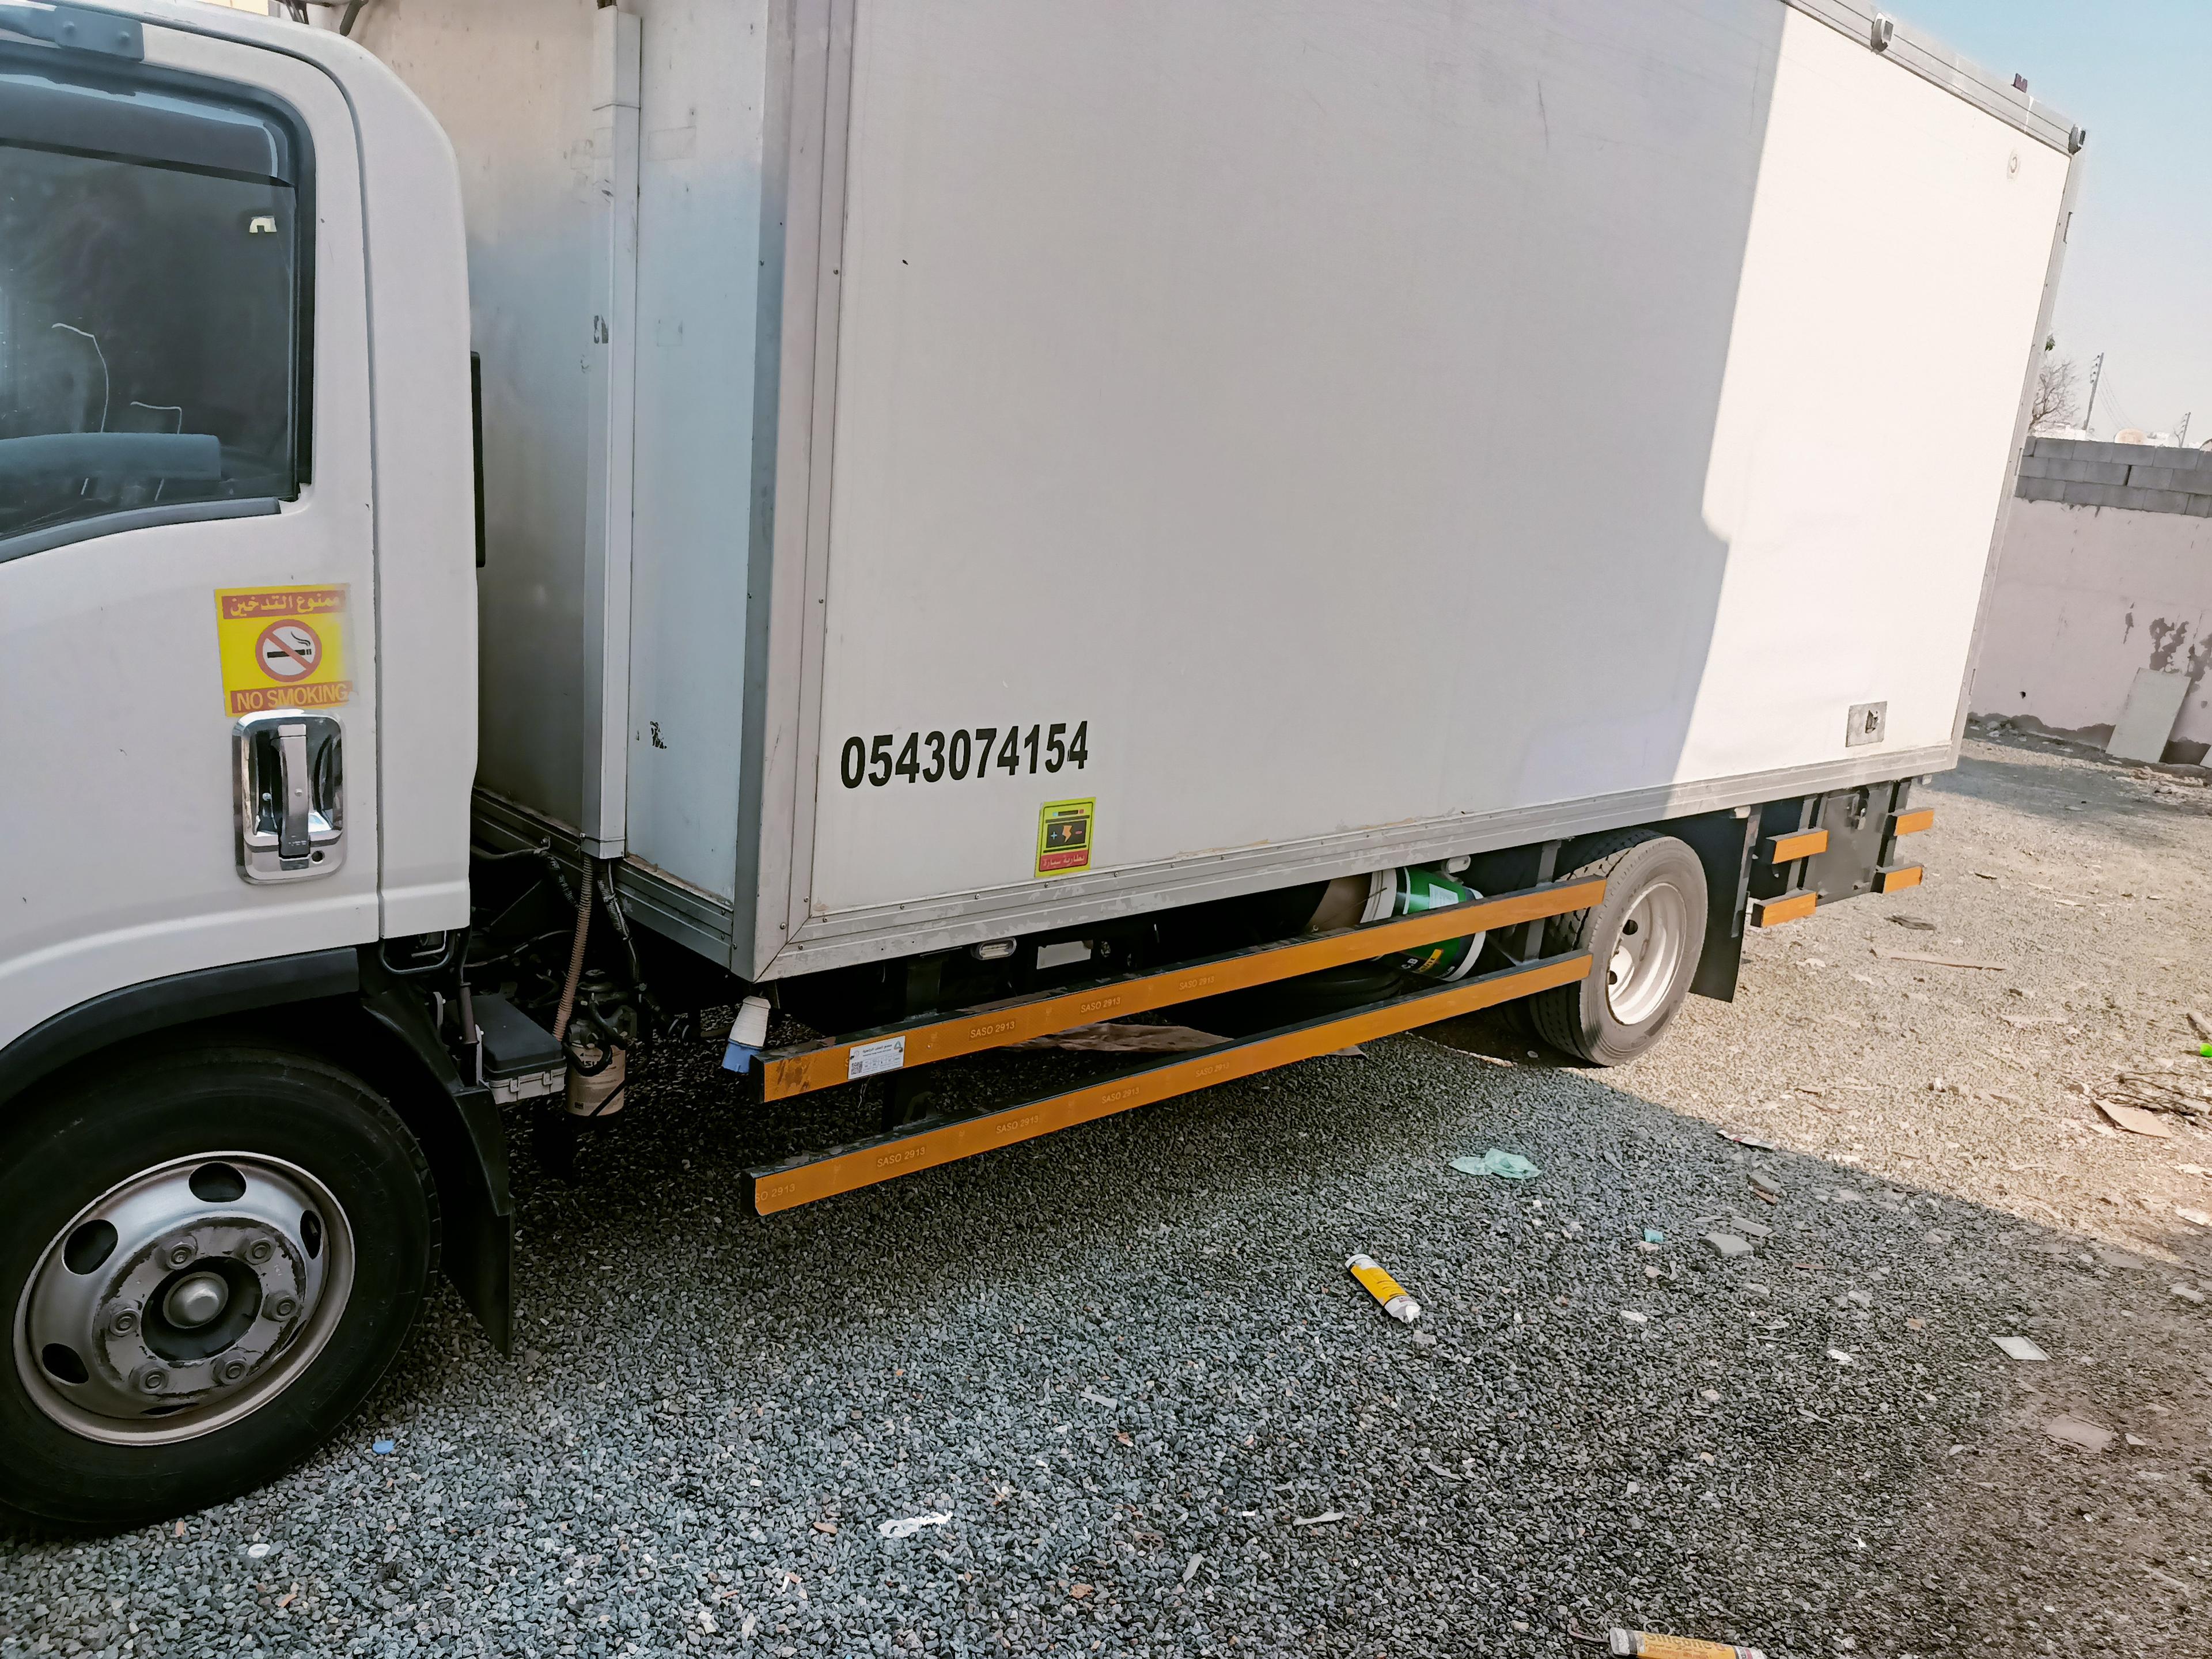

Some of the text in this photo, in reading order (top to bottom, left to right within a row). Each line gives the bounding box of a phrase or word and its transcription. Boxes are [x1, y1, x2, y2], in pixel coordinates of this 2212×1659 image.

[230, 593, 340, 617] ممنوع التدخين
[236, 683, 349, 711] NO SMOKING
[841, 720, 1088, 789] 0543074154
[1179, 979, 1198, 991] SASO
[1081, 997, 1121, 1013] SASO 2913
[970, 1021, 1015, 1038] SASO 2913
[1195, 1066, 1213, 1078] SASO
[1101, 1086, 1139, 1104] SASO 2913
[995, 1115, 1039, 1134] SASO 2913
[877, 1146, 925, 1168] SASO 2913
[756, 1183, 796, 1203] SO 2913
